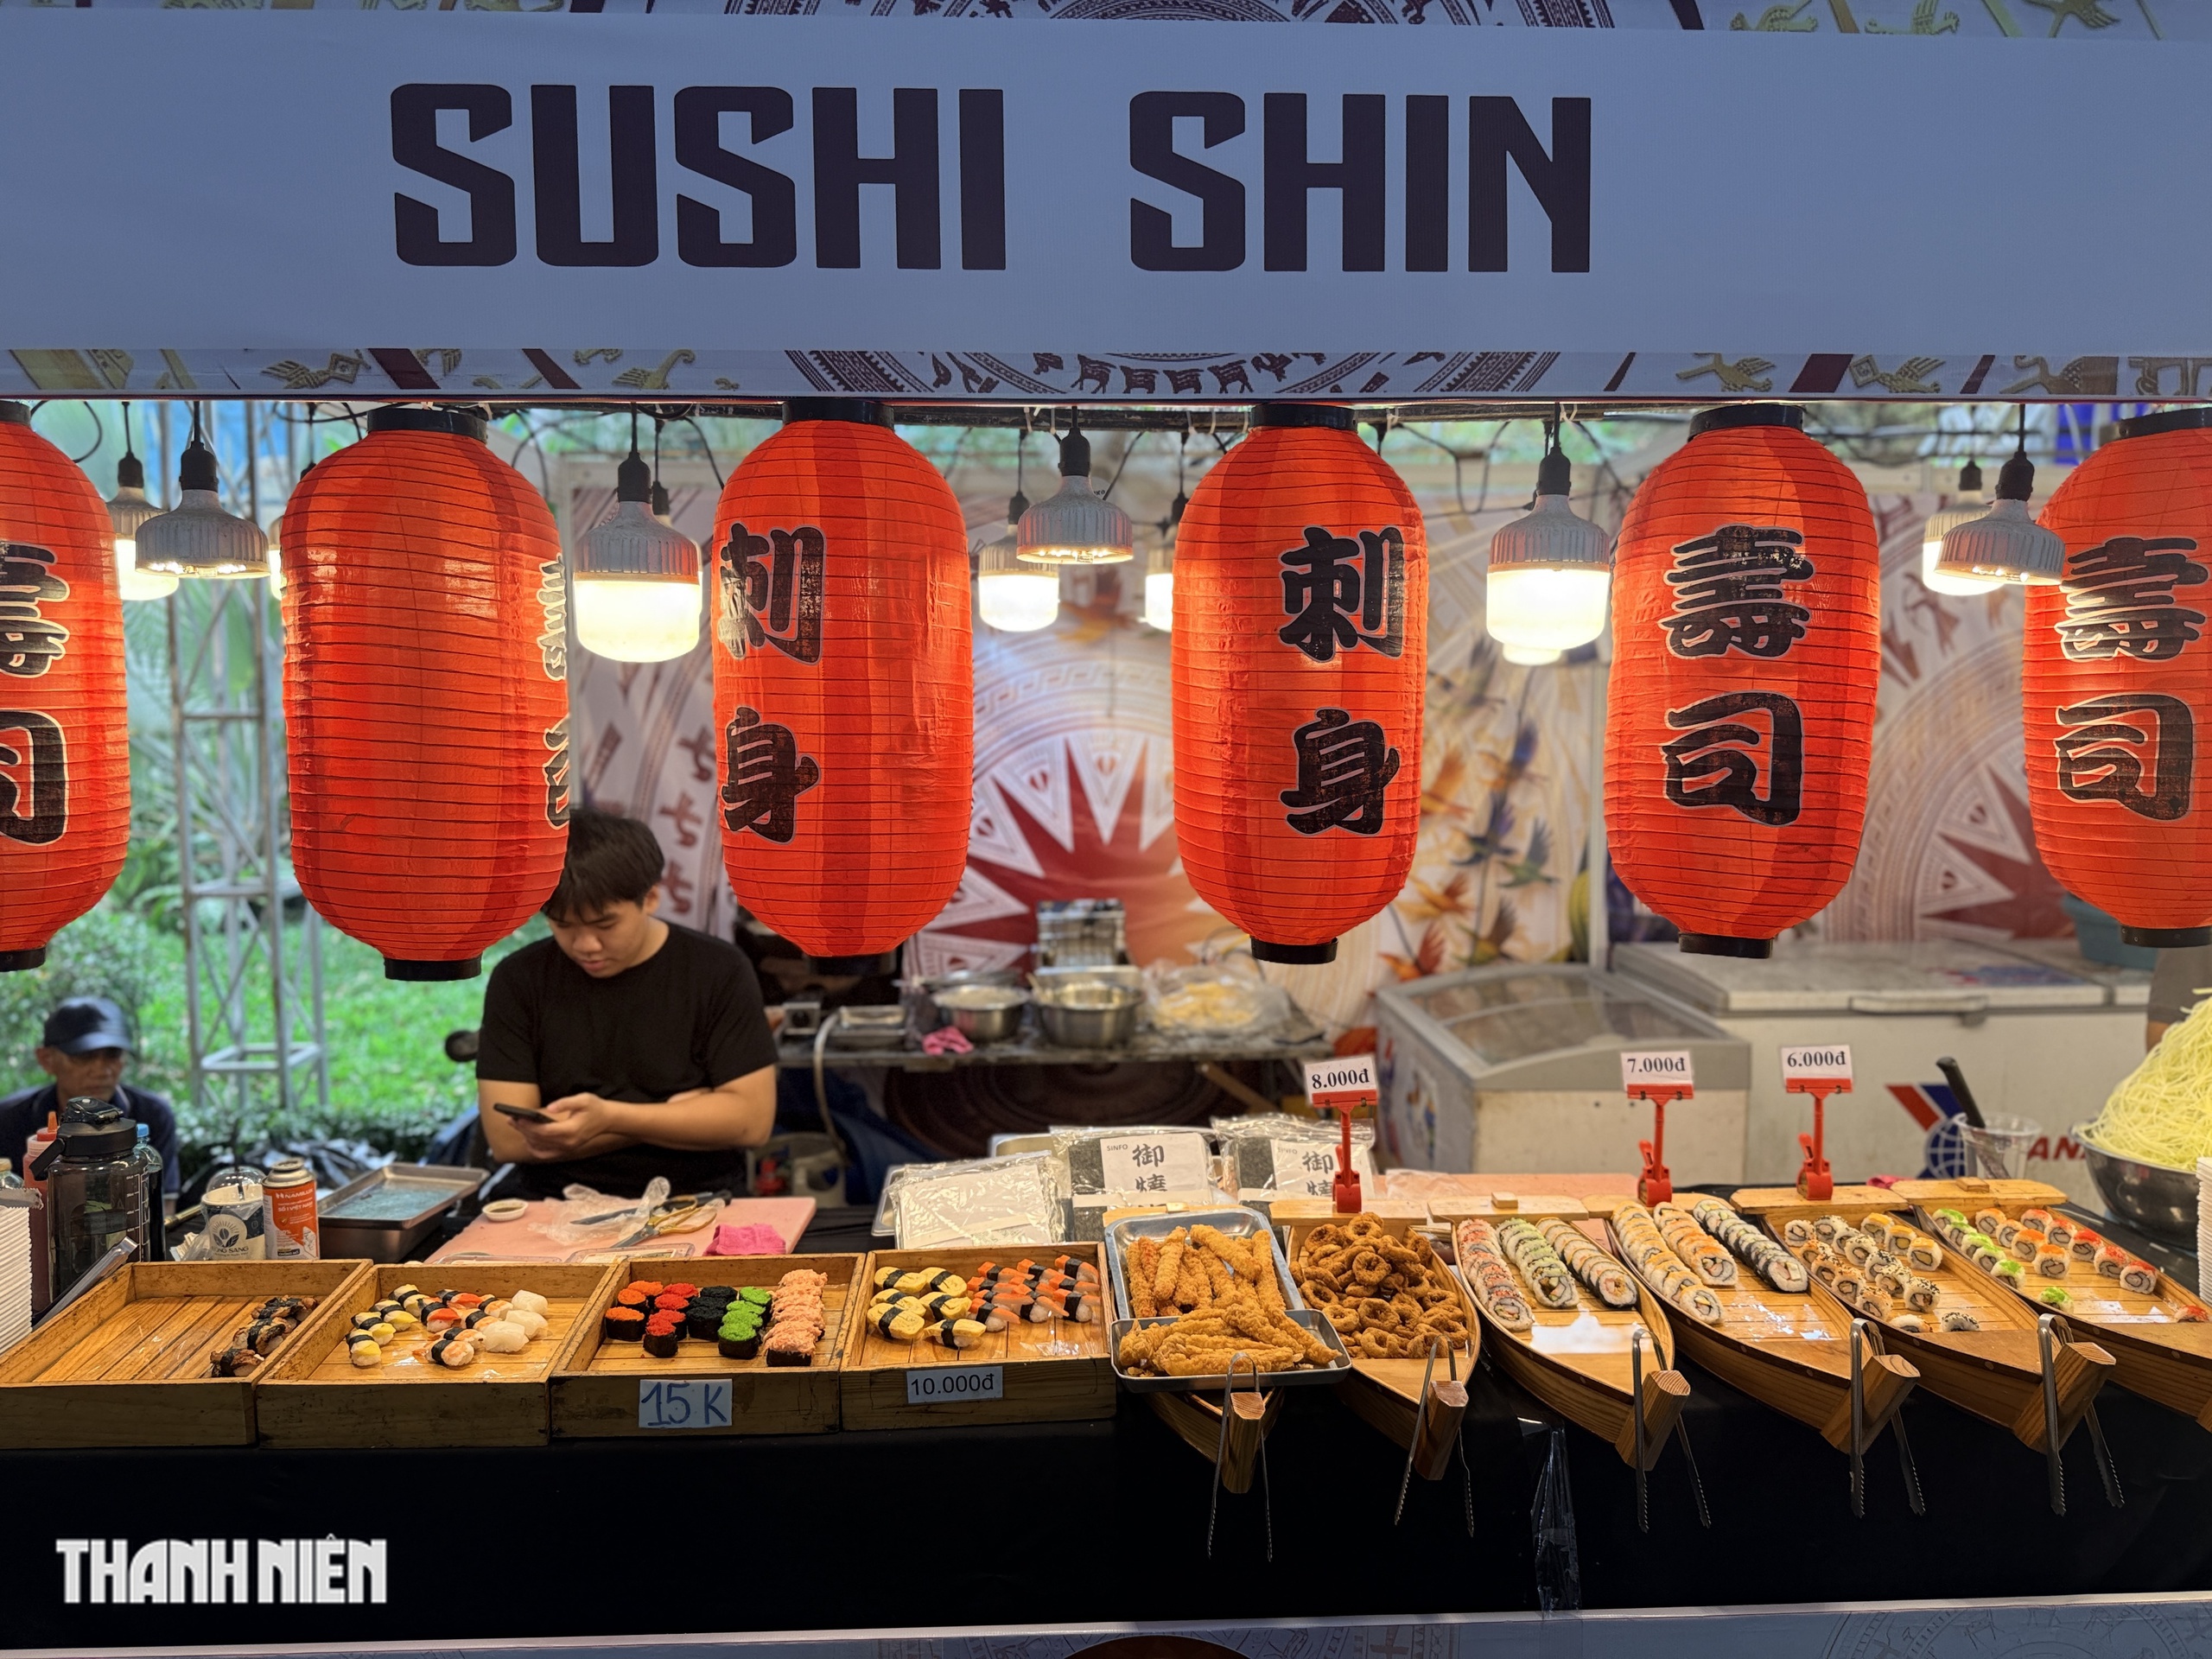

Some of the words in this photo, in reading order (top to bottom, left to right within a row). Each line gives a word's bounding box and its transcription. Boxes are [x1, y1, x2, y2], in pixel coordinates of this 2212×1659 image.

[390, 83, 1006, 270] SUSHI
[1129, 91, 1592, 271] SHIN
[716, 521, 826, 845] 刺身
[1278, 525, 1406, 836] 刺身
[1626, 1057, 1686, 1073] 7.000đ
[1787, 1051, 1847, 1068] 6.000đ
[1312, 1068, 1370, 1090] 8.000đ
[1106, 1143, 1128, 1152] SINFO
[911, 1373, 995, 1396] 10.000đ
[641, 1382, 691, 1427] 15
[703, 1382, 728, 1425] K
